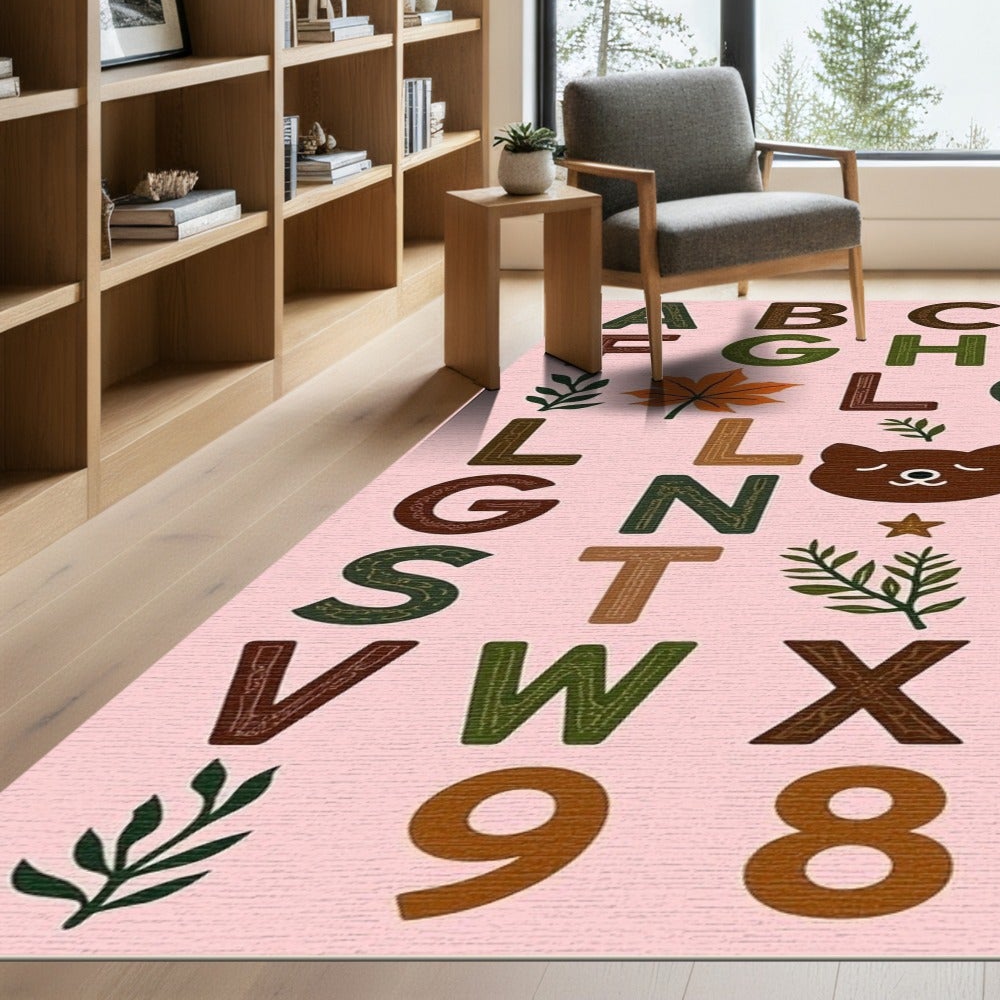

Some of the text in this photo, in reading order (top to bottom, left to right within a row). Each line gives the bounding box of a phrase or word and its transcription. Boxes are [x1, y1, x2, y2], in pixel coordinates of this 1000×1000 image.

[755, 302, 848, 330] B
[721, 333, 841, 367] G
[885, 334, 988, 367] H
[839, 371, 938, 411] L
[467, 417, 582, 466] L
[693, 417, 804, 466] L
[393, 474, 560, 535] G
[618, 474, 780, 535] N
[291, 545, 494, 626] S
[578, 545, 724, 625] T
[208, 640, 971, 746] V W X
[395, 766, 610, 921] 9
[743, 765, 954, 920] 8
